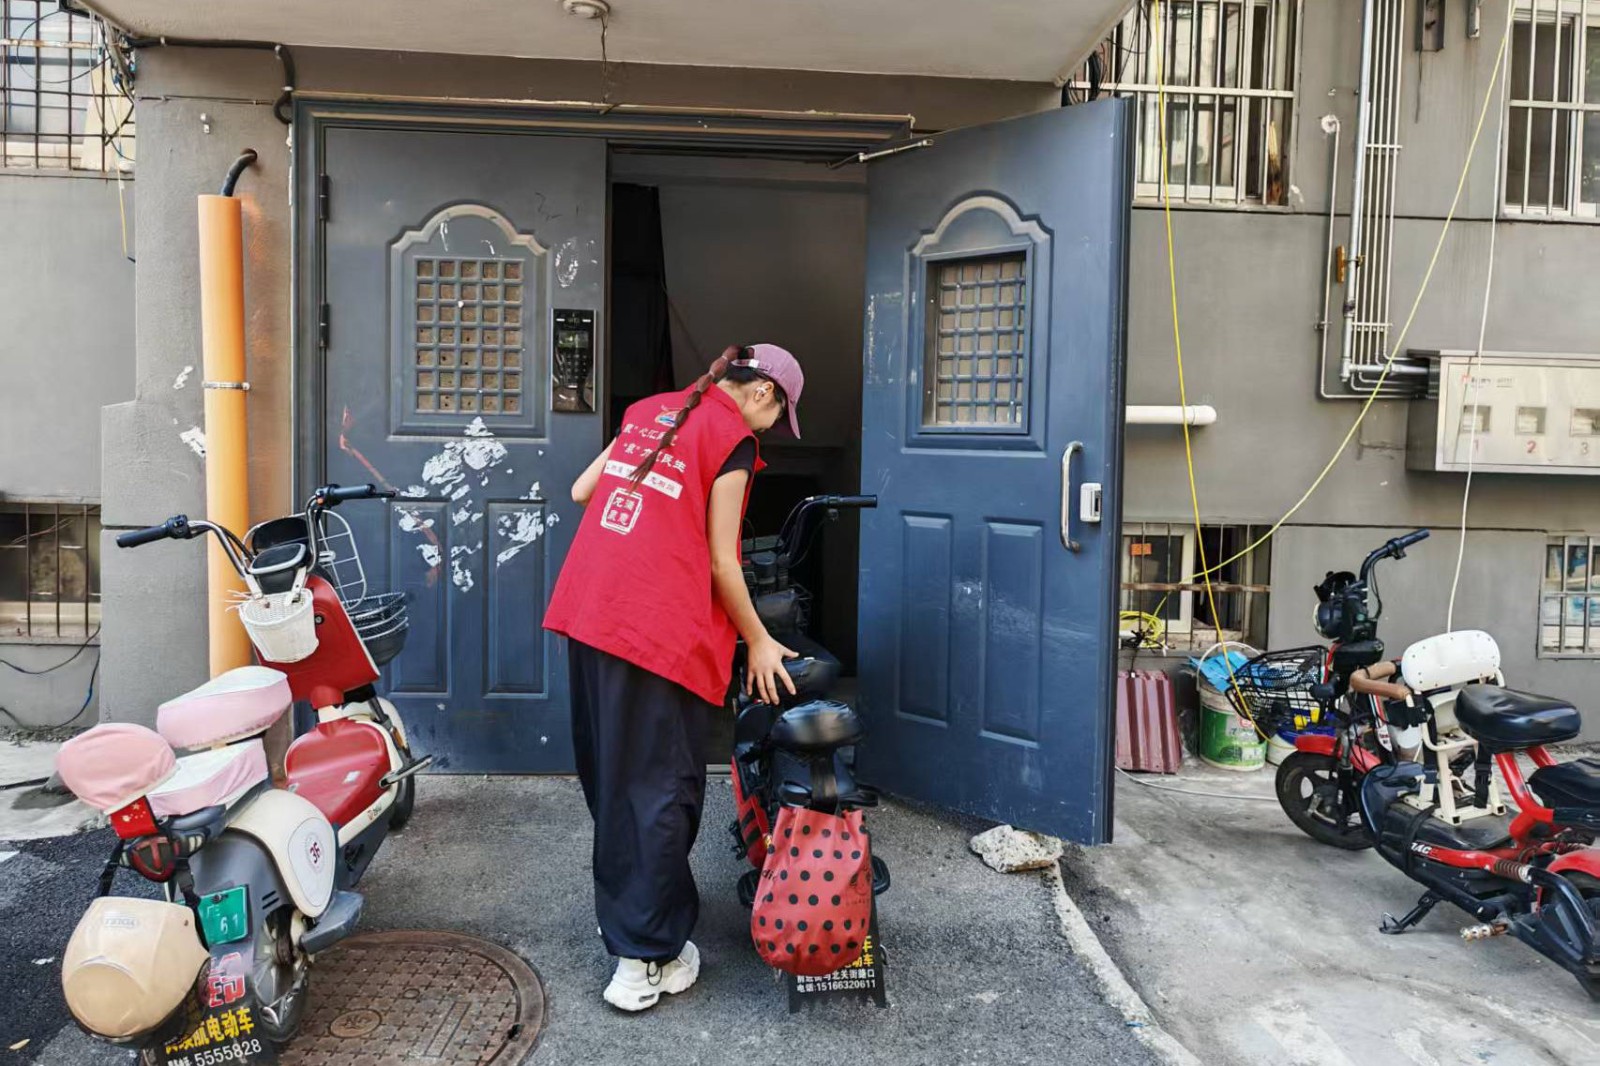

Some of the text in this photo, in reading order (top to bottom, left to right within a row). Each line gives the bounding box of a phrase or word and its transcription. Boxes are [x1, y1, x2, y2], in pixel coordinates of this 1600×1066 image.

[1526, 440, 1537, 454] 2
[1580, 441, 1589, 455] 3
[194, 1038, 262, 1066] 5555828
